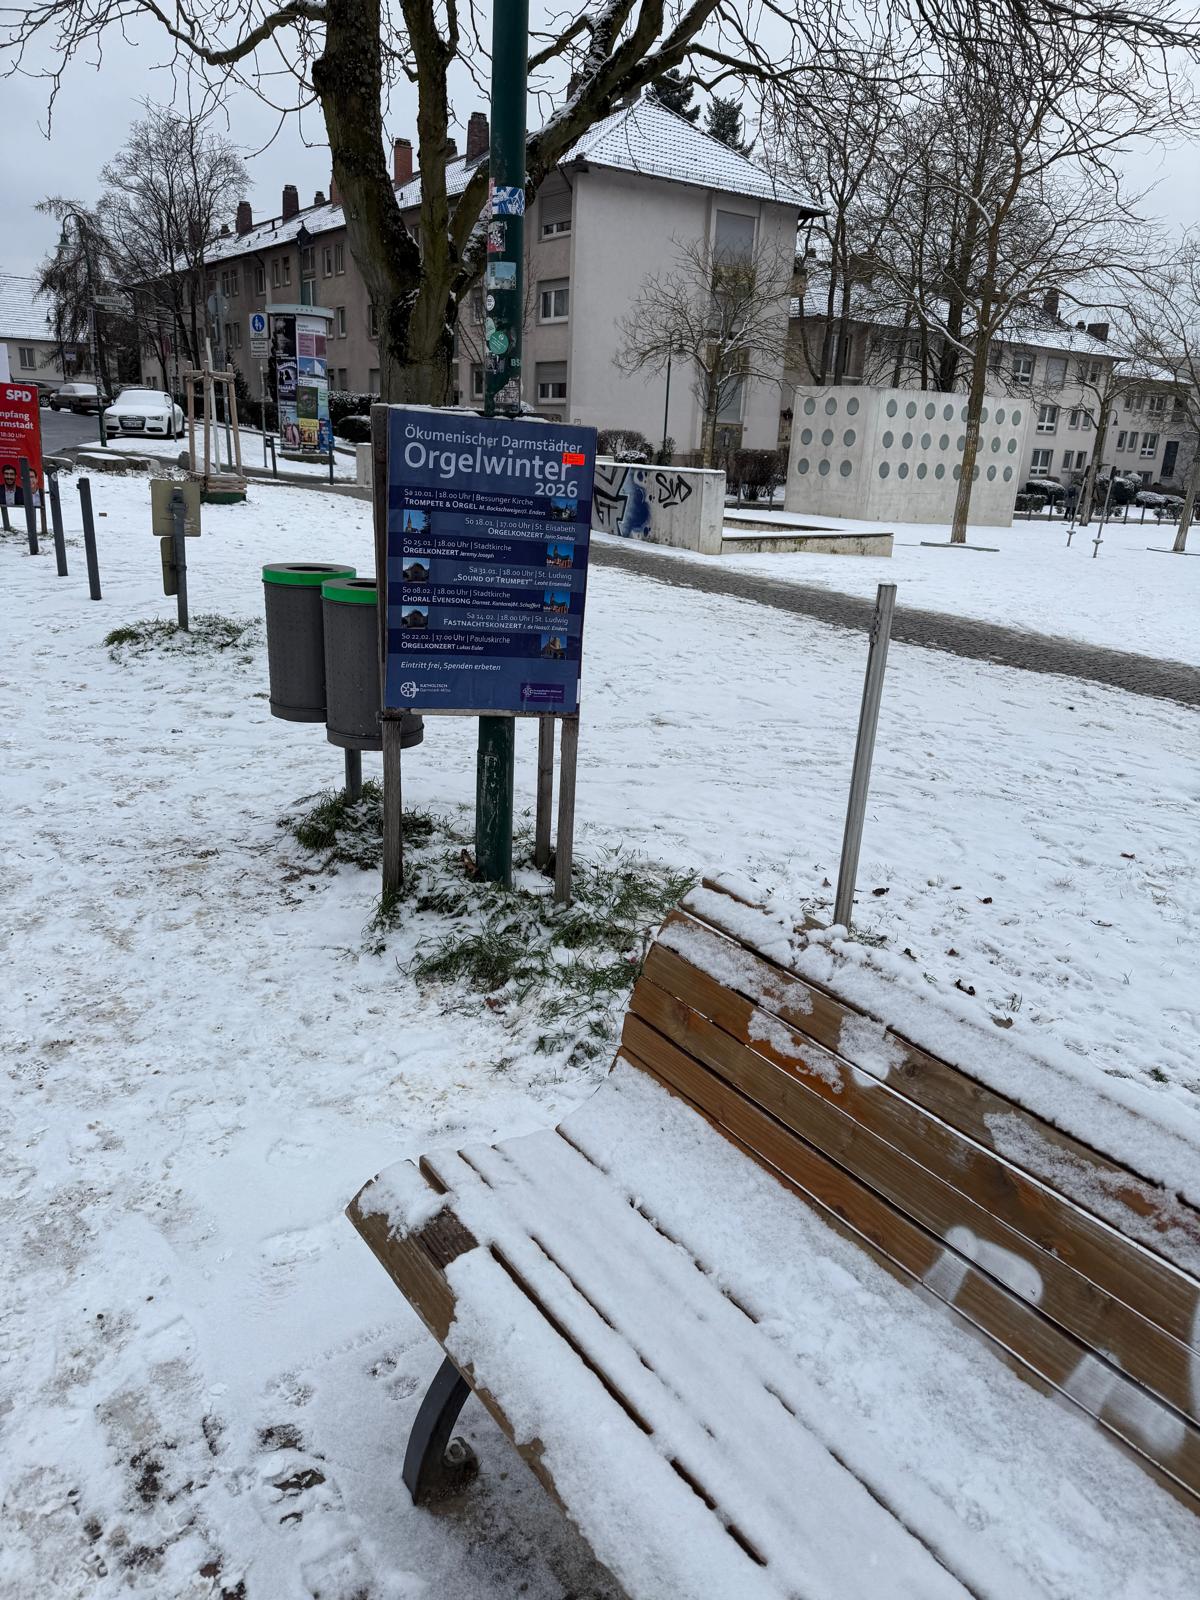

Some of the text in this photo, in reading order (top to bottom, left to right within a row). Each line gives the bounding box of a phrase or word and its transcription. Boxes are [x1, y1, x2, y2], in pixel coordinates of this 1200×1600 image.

[6, 389, 32, 402] SPD
[0, 422, 34, 430] rmstadt
[405, 424, 582, 454] Ökumenischer Darmstädter
[404, 442, 571, 481] Orgelwinter
[535, 481, 578, 498] 2026
[404, 498, 443, 506] TROMPETE
[452, 501, 478, 509] ORGEL
[476, 494, 510, 504] Bessunger
[488, 528, 544, 538] ORGELKONZERT
[546, 524, 576, 532] Elisabeth
[403, 546, 459, 556] ORGELKONZERT
[474, 542, 512, 551] Stadtkirche
[548, 571, 572, 580] Ludwig
[402, 594, 430, 603] CHORAL
[432, 596, 470, 604] EVENSONG
[473, 590, 510, 598] Stadtkirche
[444, 619, 522, 629] FASTNACHTSKONZERT
[544, 616, 568, 625] Ludwig
[470, 635, 510, 644] Pauluskirche
[427, 661, 442, 670] frei,
[444, 662, 473, 670] Spenden
